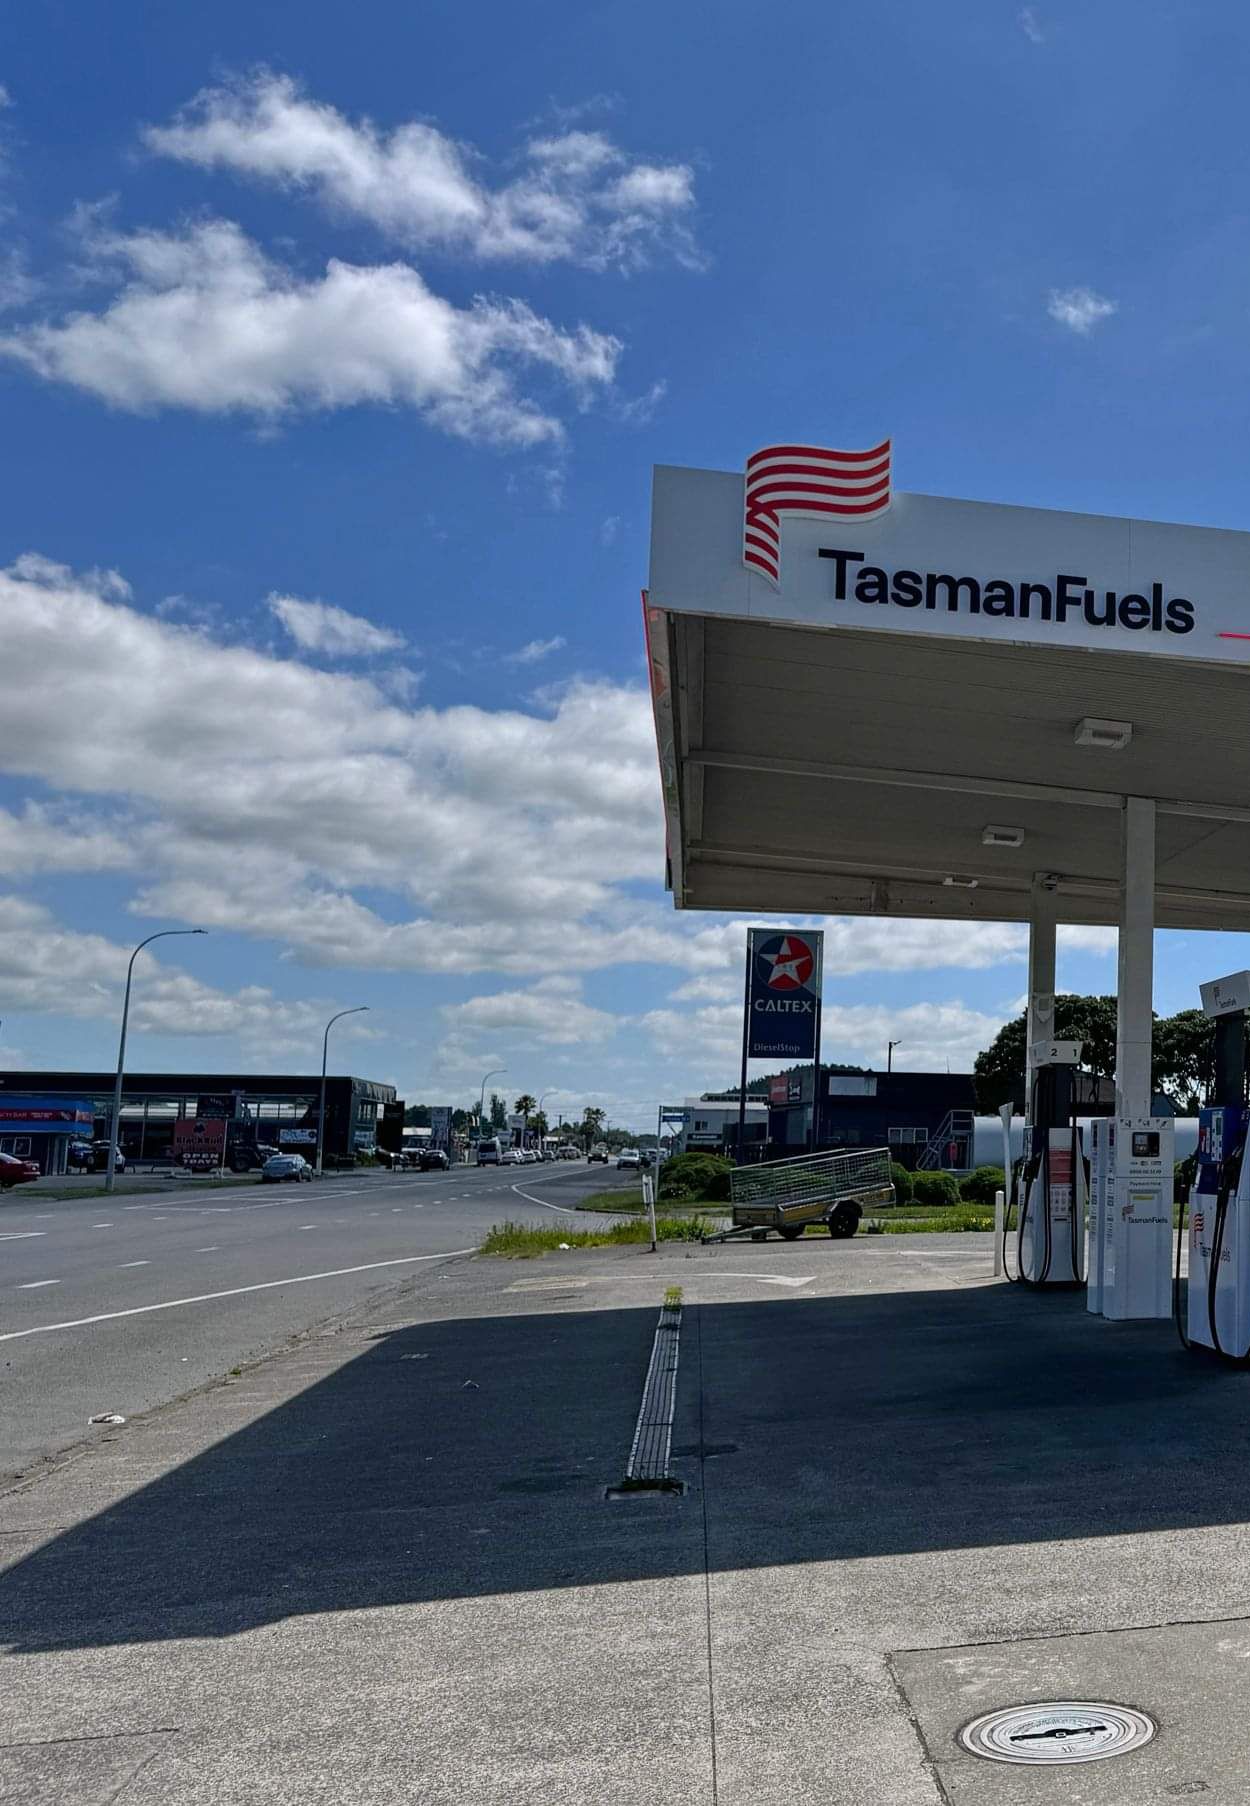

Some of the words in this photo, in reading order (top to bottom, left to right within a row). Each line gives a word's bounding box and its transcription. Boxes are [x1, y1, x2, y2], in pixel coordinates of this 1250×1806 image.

[818, 547, 1195, 634] TasmanFuels
[754, 999, 813, 1013] CALTEX
[753, 1043, 801, 1054] DieselStop
[1051, 1048, 1057, 1057] 2
[1073, 1048, 1077, 1057] 1
[1128, 1216, 1169, 1224] TasmanFuels
